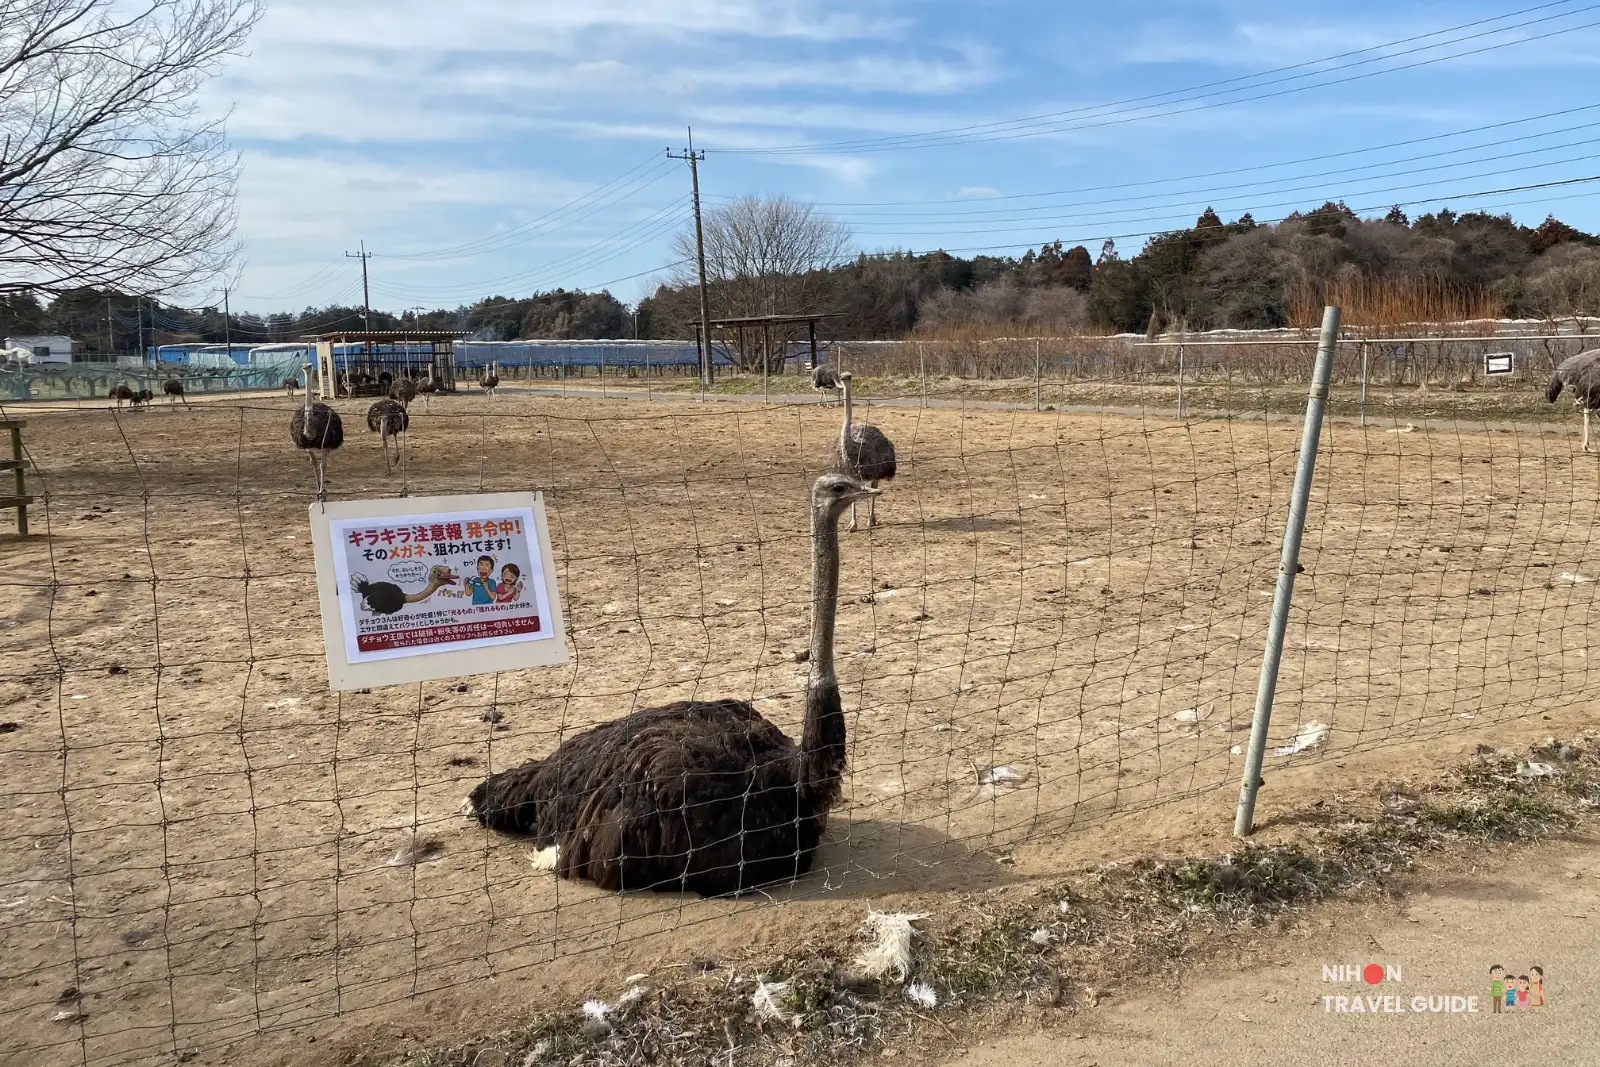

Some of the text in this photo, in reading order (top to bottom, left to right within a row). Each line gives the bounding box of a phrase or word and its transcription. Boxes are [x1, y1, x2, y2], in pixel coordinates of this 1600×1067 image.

[348, 519, 521, 547] キラキラ注意報 発令中!
[362, 538, 512, 562] そのメガネ、狙われてます!
